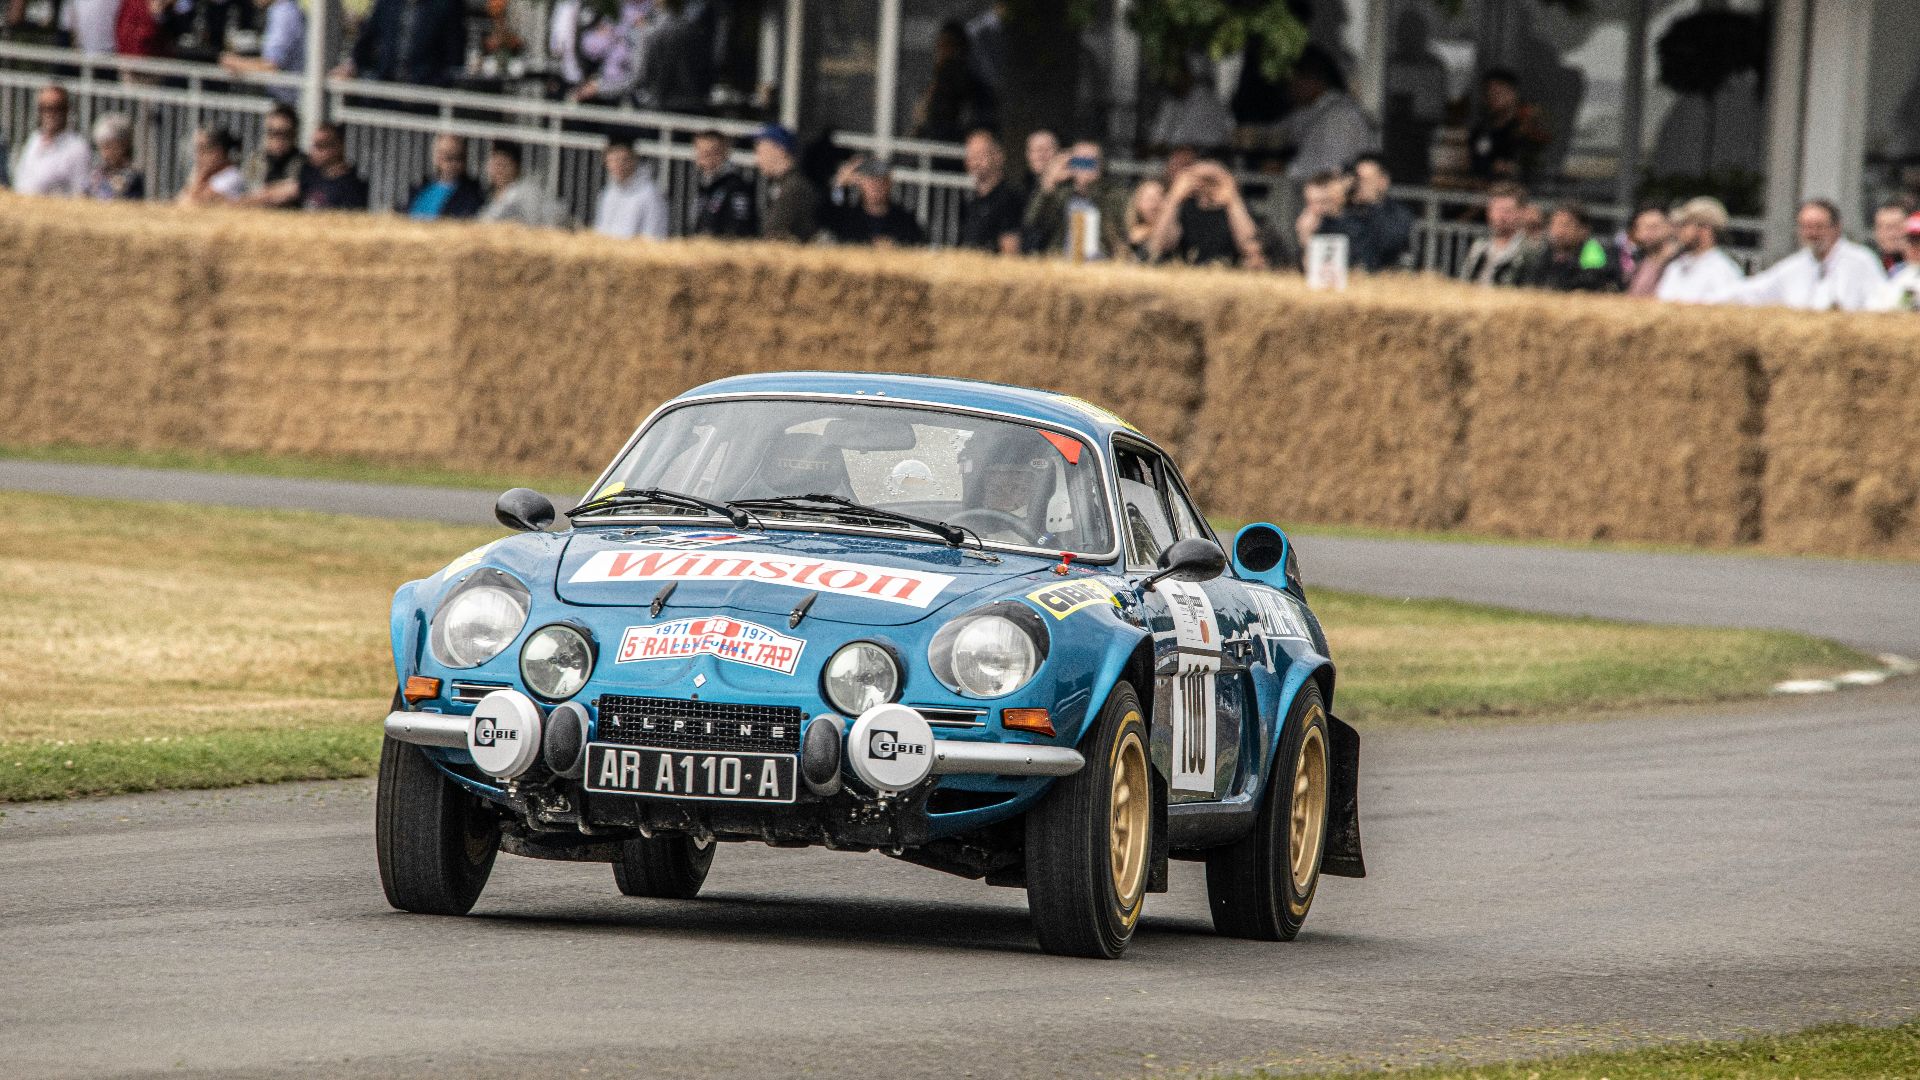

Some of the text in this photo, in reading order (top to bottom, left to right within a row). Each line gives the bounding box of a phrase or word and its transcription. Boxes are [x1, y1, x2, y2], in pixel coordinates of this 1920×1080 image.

[641, 538, 713, 547] elf
[607, 552, 922, 601] Winston
[656, 623, 689, 635] 1971
[741, 626, 774, 642] 1971
[643, 635, 714, 657] RALLYE
[612, 715, 784, 738] ALPINE
[599, 749, 640, 789] AR
[758, 759, 780, 797] A
